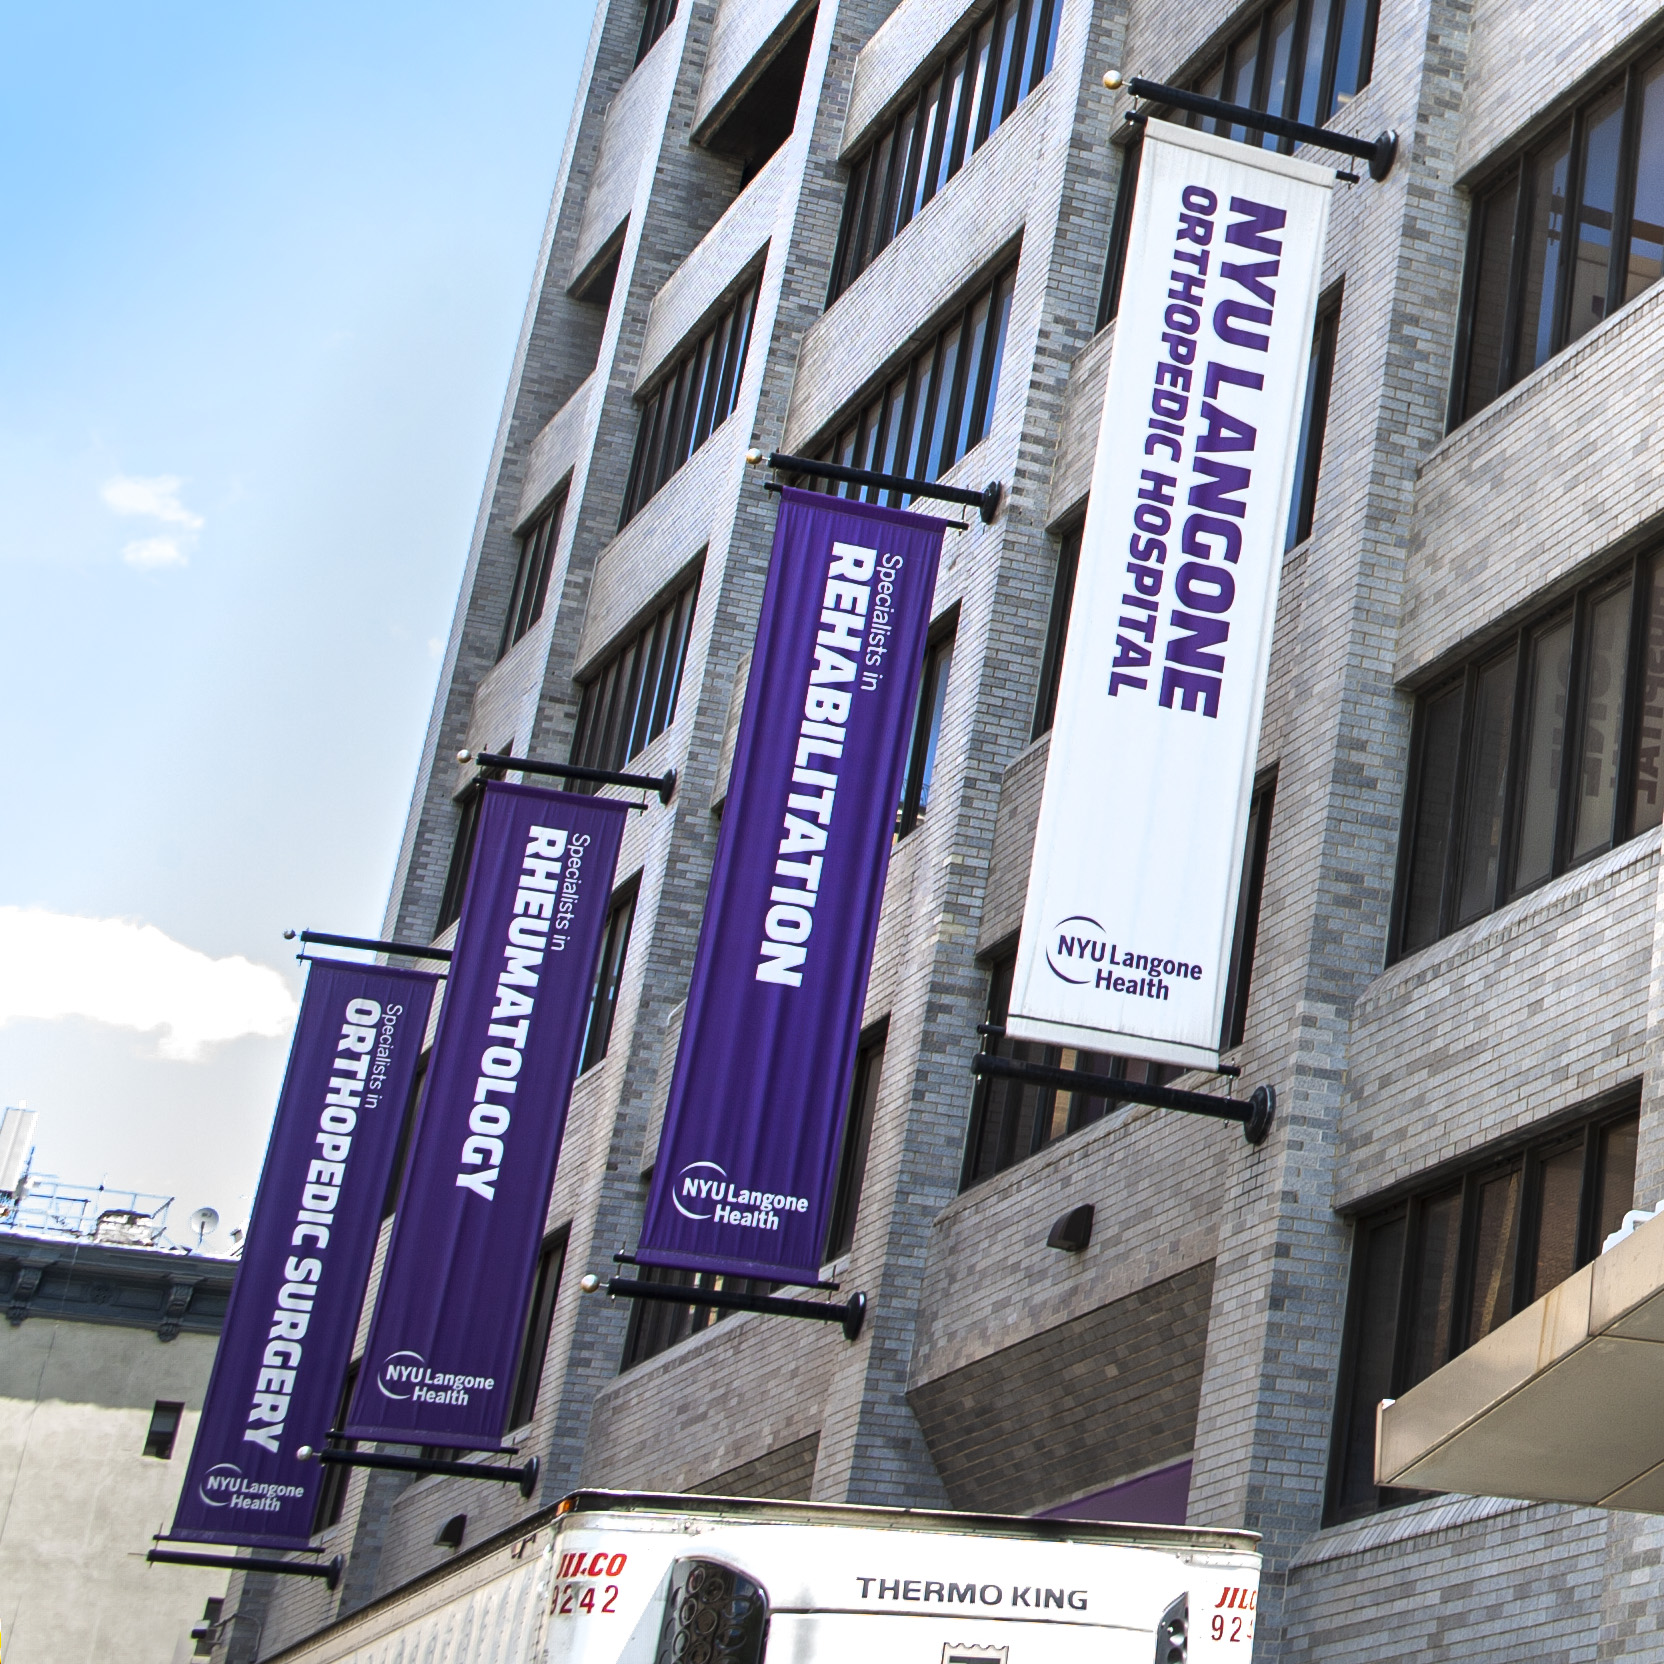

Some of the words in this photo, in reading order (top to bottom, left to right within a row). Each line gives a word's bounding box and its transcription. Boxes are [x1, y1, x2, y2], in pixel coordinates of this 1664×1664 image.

[1212, 195, 1288, 353] NYU
[1144, 184, 1218, 464] ORTHOPEDIC
[1158, 360, 1265, 719] LANGONE
[1107, 468, 1178, 698] HOSPITAL
[864, 552, 904, 667] Specialists
[860, 672, 884, 691] in
[755, 540, 878, 988] REHABILITATION
[554, 833, 591, 932] Specialists
[550, 935, 571, 951] in
[1057, 934, 1107, 963] NYU
[1109, 944, 1203, 981] Langone
[1094, 968, 1170, 1001] Health
[455, 825, 569, 1202] RHEUMATOLOGY
[369, 1003, 403, 1090] Specialists
[291, 997, 382, 1249] ORTHOPEDIC
[364, 1094, 378, 1109] in
[682, 1177, 727, 1201] NYU
[727, 1183, 809, 1213] Langone
[713, 1203, 780, 1231] Health
[242, 1255, 323, 1454] SURGERY
[385, 1364, 424, 1383] NYU
[424, 1368, 495, 1390] Langone
[411, 1385, 469, 1406] Health
[206, 1475, 242, 1492] NYU
[241, 1478, 305, 1498] Langone
[229, 1494, 281, 1512] Health
[856, 1576, 1003, 1606] THERMO
[1011, 1586, 1088, 1611] KING
